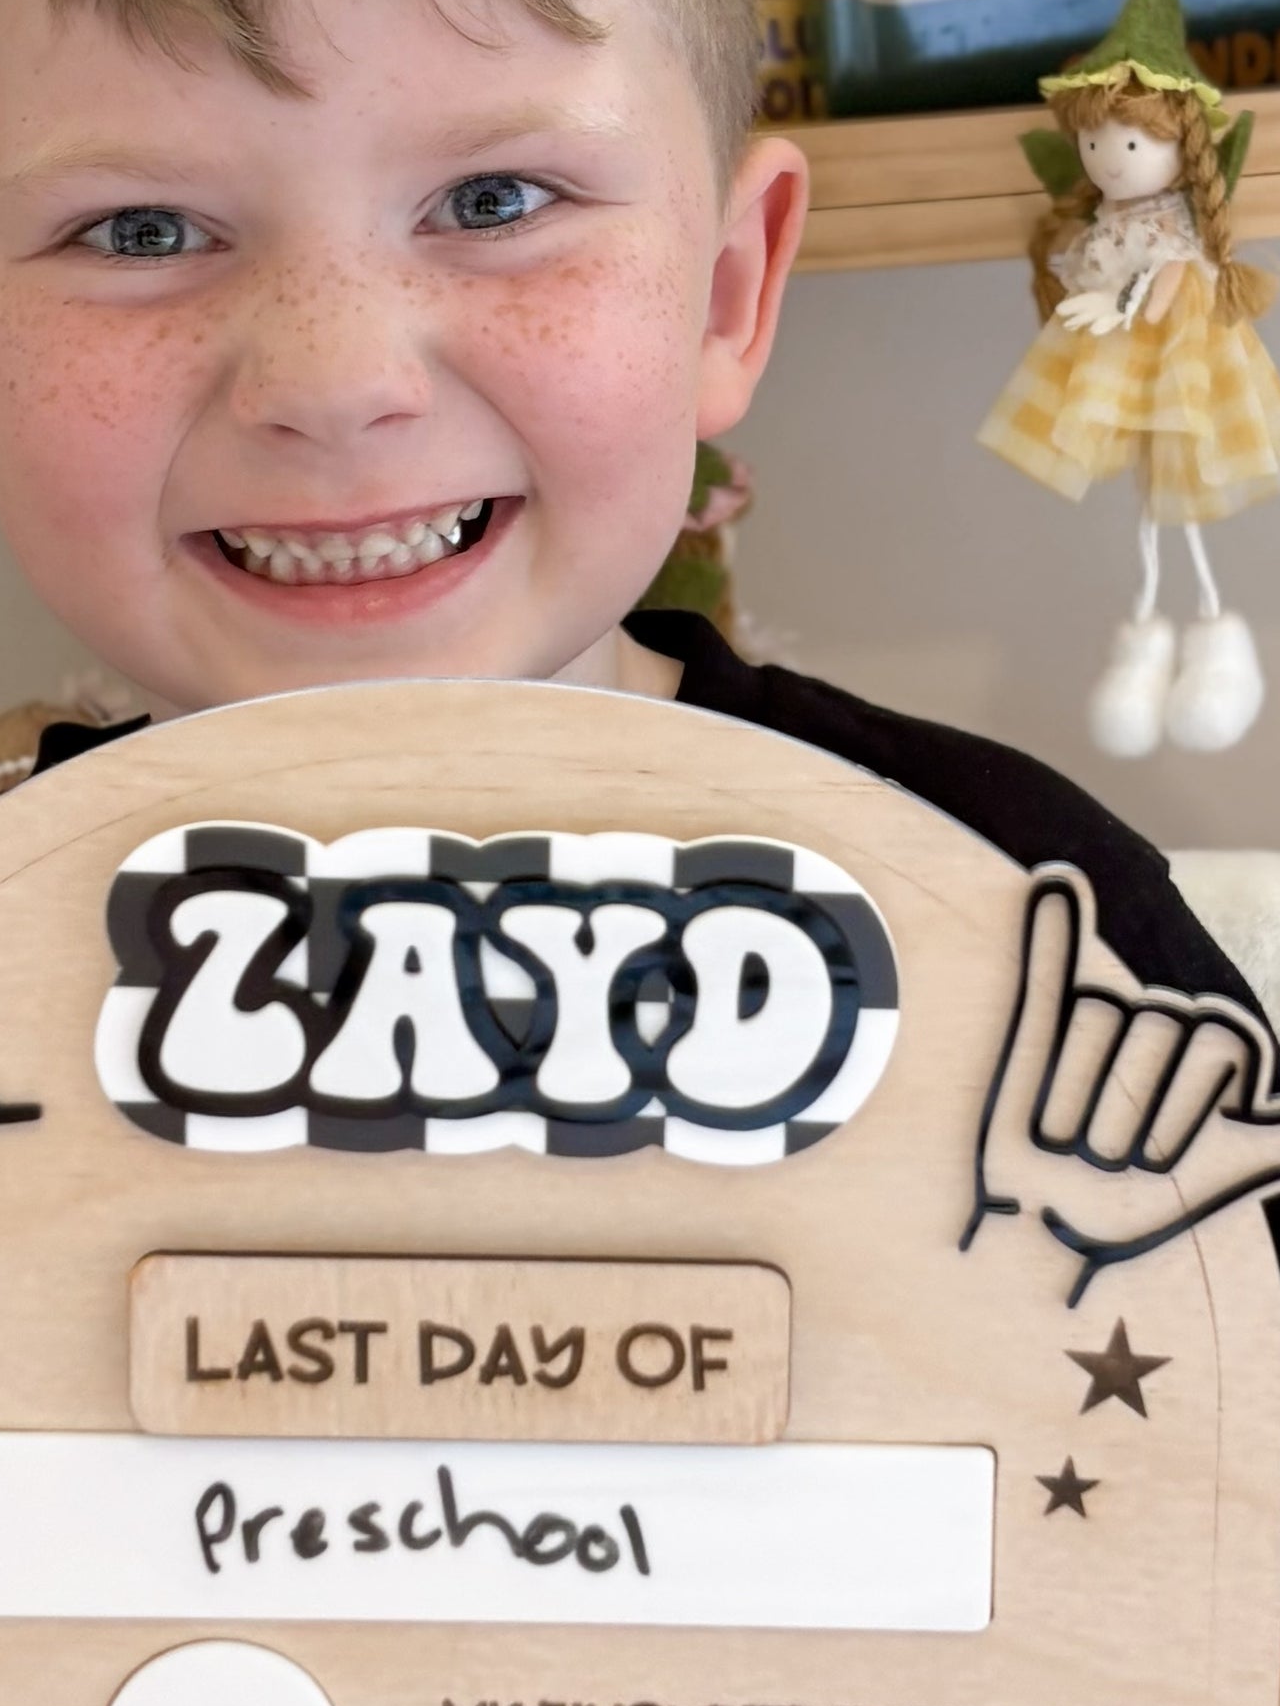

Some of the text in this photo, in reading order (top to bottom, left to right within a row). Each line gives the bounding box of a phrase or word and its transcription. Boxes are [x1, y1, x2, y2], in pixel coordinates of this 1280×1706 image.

[156, 887, 836, 1111] ZAYD
[185, 1316, 734, 1392] LAST DAY OF
